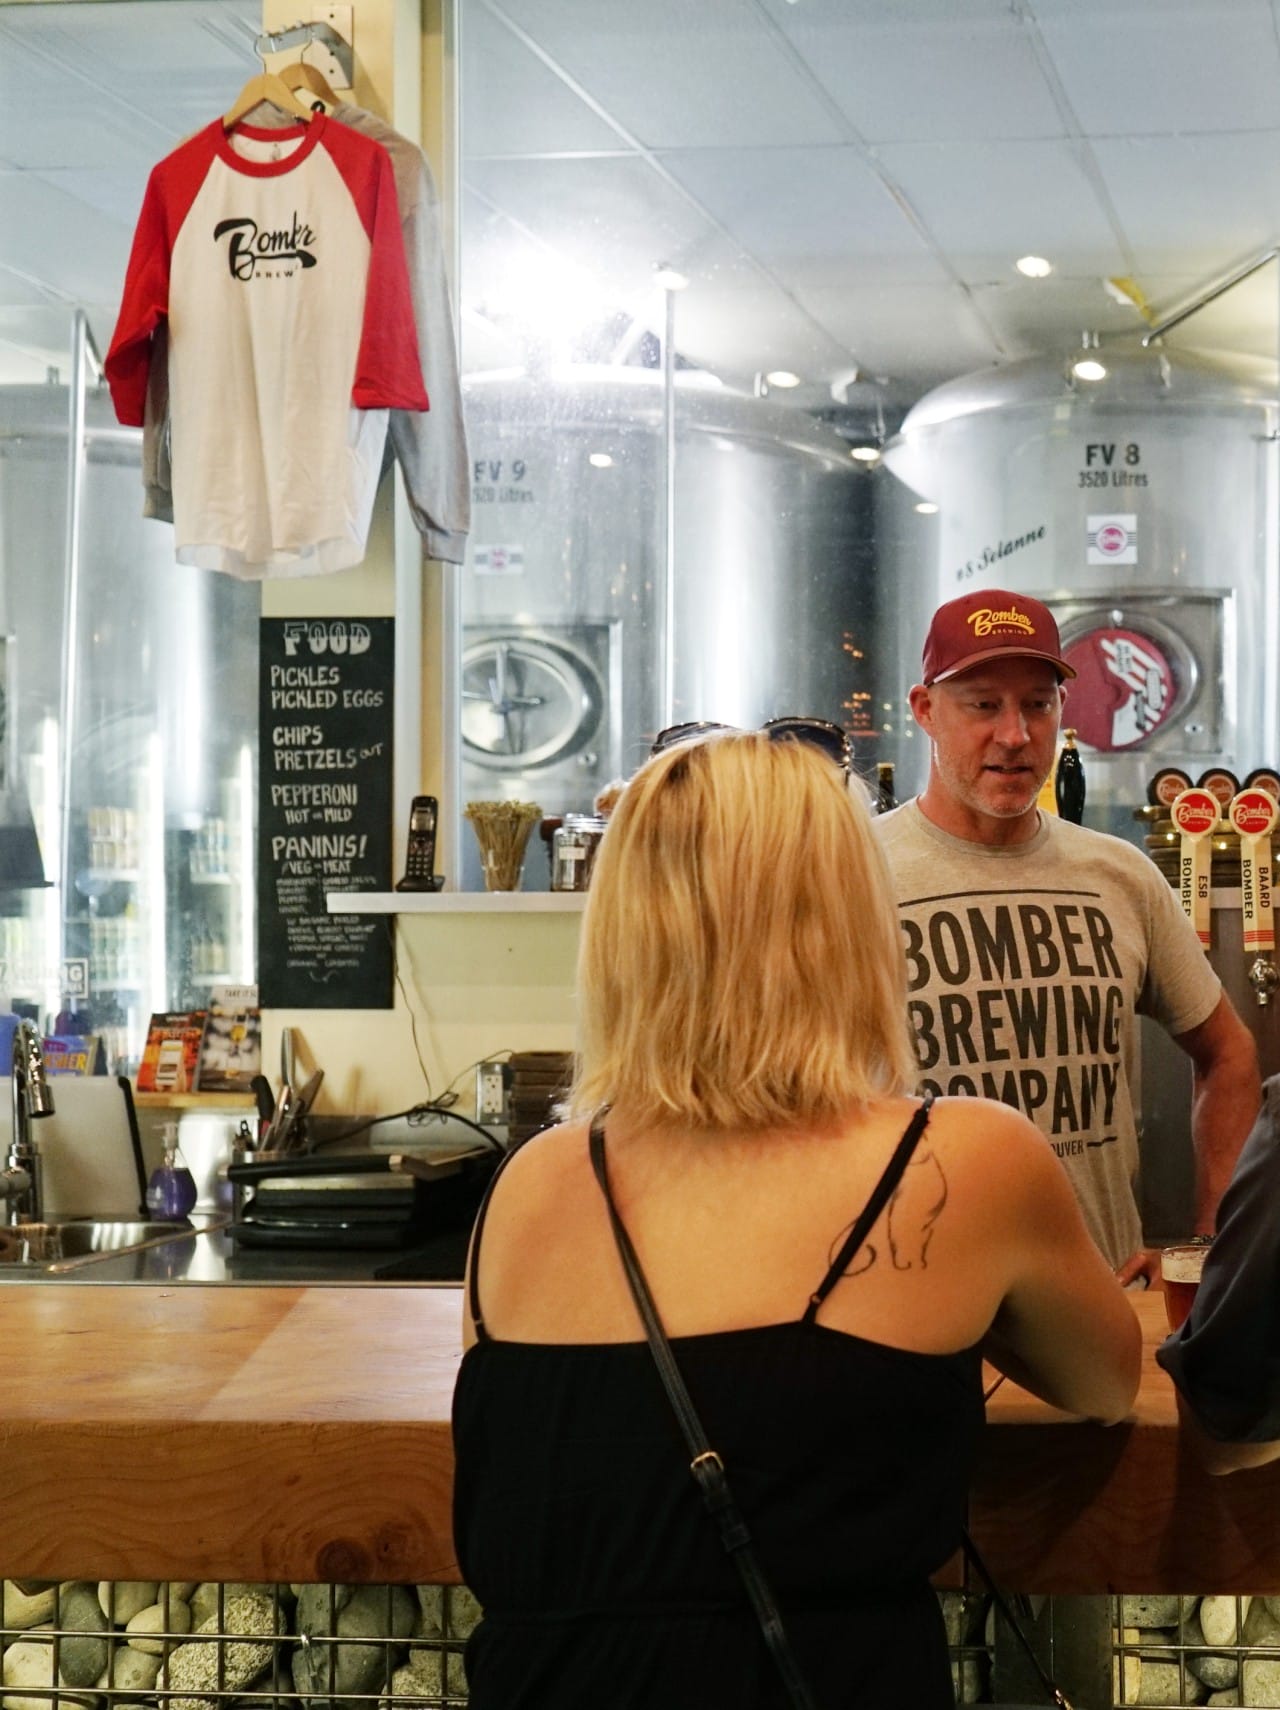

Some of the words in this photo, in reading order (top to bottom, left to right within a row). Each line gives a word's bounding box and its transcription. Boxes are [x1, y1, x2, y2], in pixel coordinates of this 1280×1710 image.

[1086, 444, 1116, 467] FV
[1125, 444, 1140, 466] 8
[474, 459, 502, 482] FV
[512, 459, 525, 481] 9
[1078, 471, 1108, 488] 3520
[1112, 470, 1149, 488] Litres
[967, 606, 1036, 637] Bomber
[283, 621, 372, 657] FOOD
[270, 664, 340, 688] PICKLES
[271, 689, 338, 710] PICKLED
[342, 688, 384, 709] EGGS
[272, 725, 323, 746] CHIPS
[274, 748, 357, 771] PRETZELS
[271, 783, 358, 807] PEPPERONI
[284, 807, 310, 825] HOT
[323, 807, 353, 823] MILD
[1178, 802, 1214, 824] Bomber
[1235, 801, 1271, 824] Bomber
[271, 834, 368, 861] PANINIS!
[1198, 875, 1208, 898] ESB
[1243, 859, 1253, 919] BOMBER
[1258, 867, 1271, 908] BAARD
[900, 904, 1123, 992] BOMBER
[907, 985, 1124, 1071] BREWING
